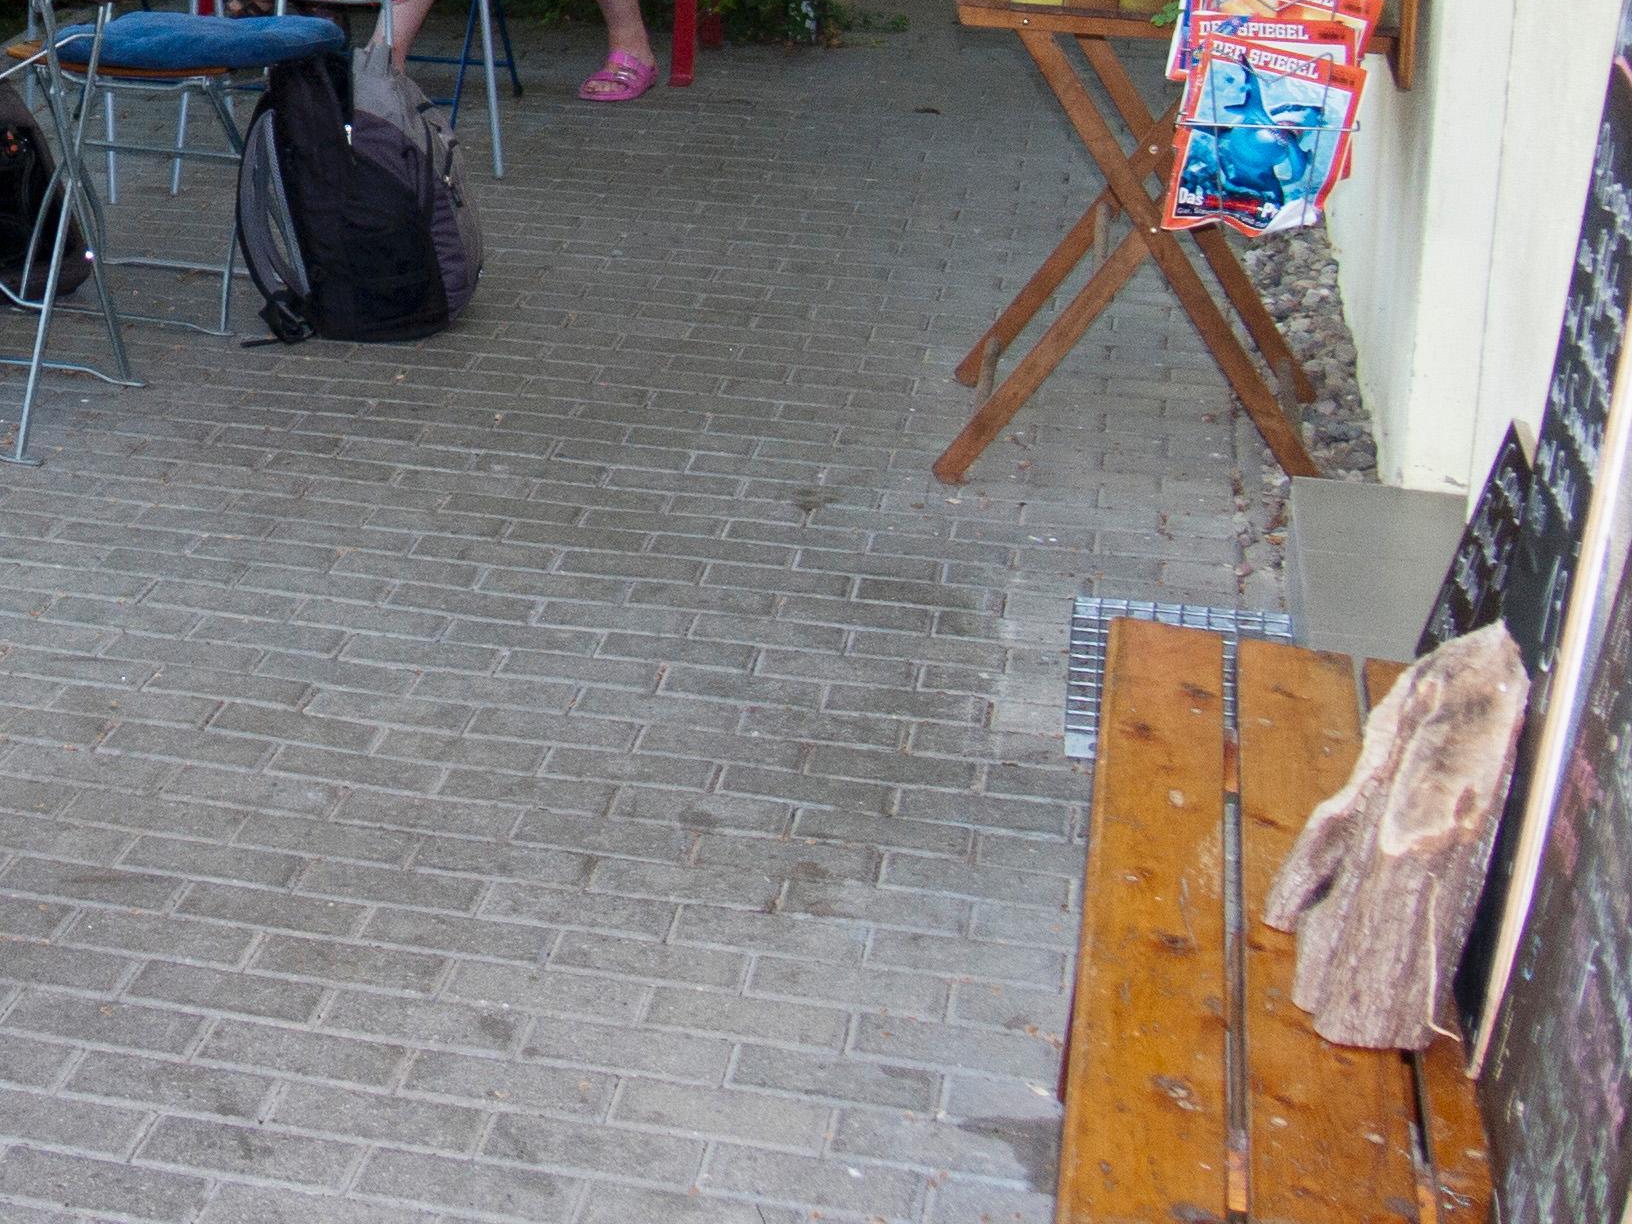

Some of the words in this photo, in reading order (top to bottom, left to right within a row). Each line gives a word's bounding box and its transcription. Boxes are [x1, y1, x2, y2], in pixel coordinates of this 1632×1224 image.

[1237, 22, 1309, 40] SPIEGEL
[1248, 48, 1319, 78] SPIEGEL
[1178, 186, 1204, 206] Das
